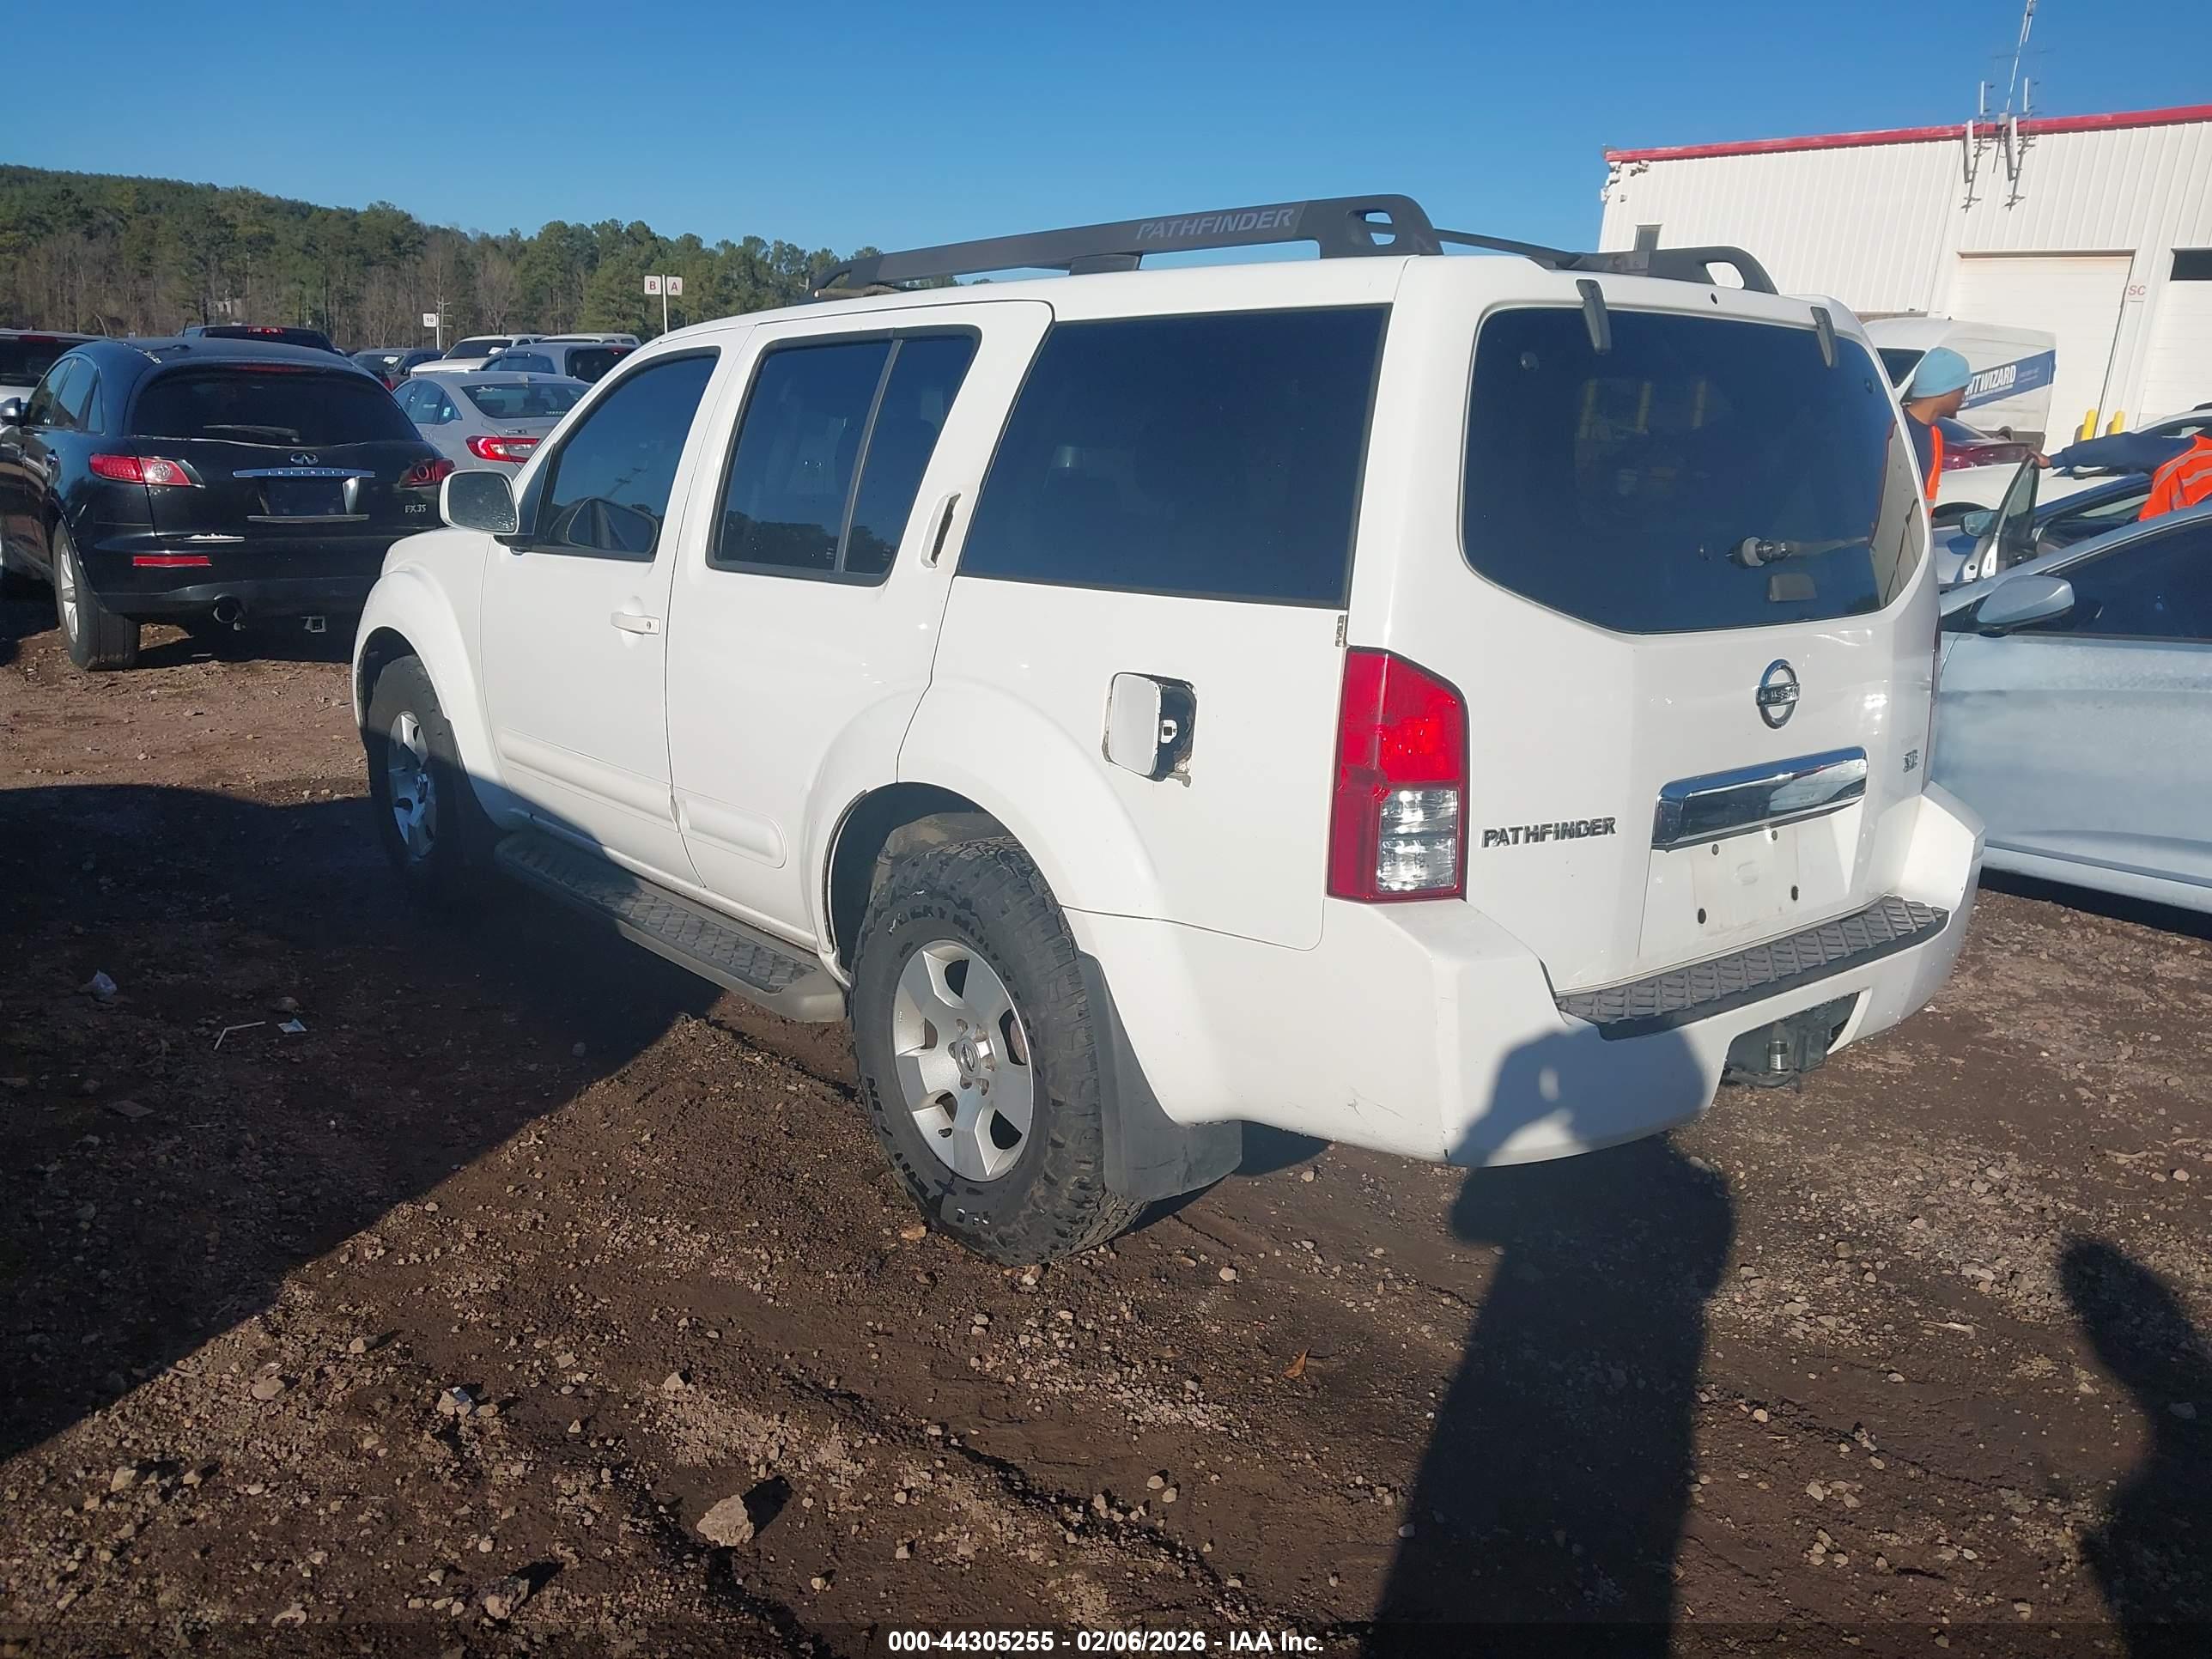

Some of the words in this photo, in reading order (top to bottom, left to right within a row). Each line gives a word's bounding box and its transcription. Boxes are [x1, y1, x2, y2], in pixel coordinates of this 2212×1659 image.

[1135, 208, 1295, 240] PATHFINDER
[2128, 284, 2147, 296] SC
[1481, 816, 1617, 848] PATHFINDER
